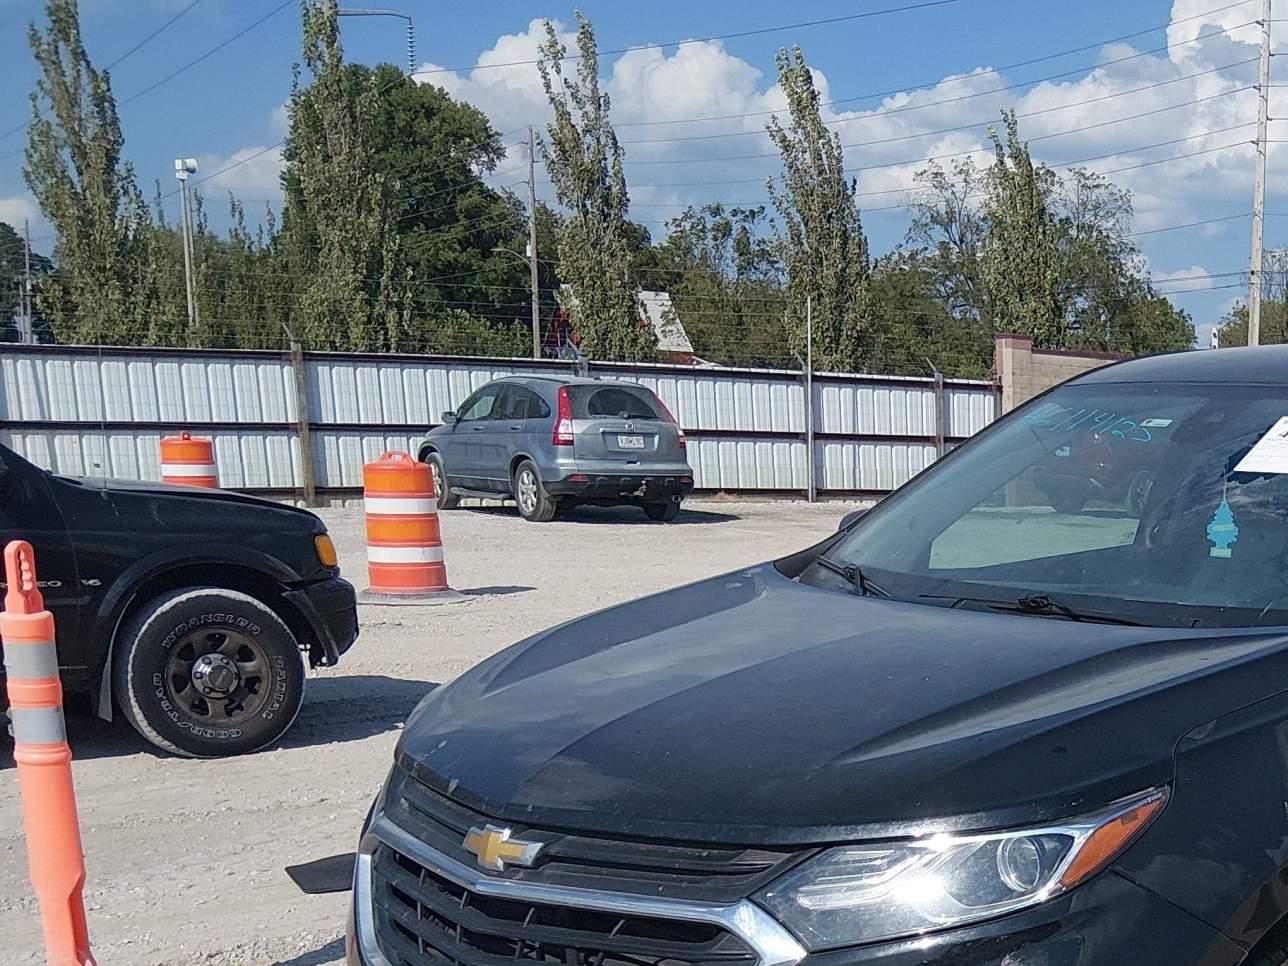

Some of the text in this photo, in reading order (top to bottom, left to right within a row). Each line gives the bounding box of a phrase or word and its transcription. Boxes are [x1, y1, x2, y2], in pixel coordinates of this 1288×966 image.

[81, 578, 103, 587] V6
[162, 613, 261, 648] WRANGLER
[153, 672, 242, 739] GOODYEAR
